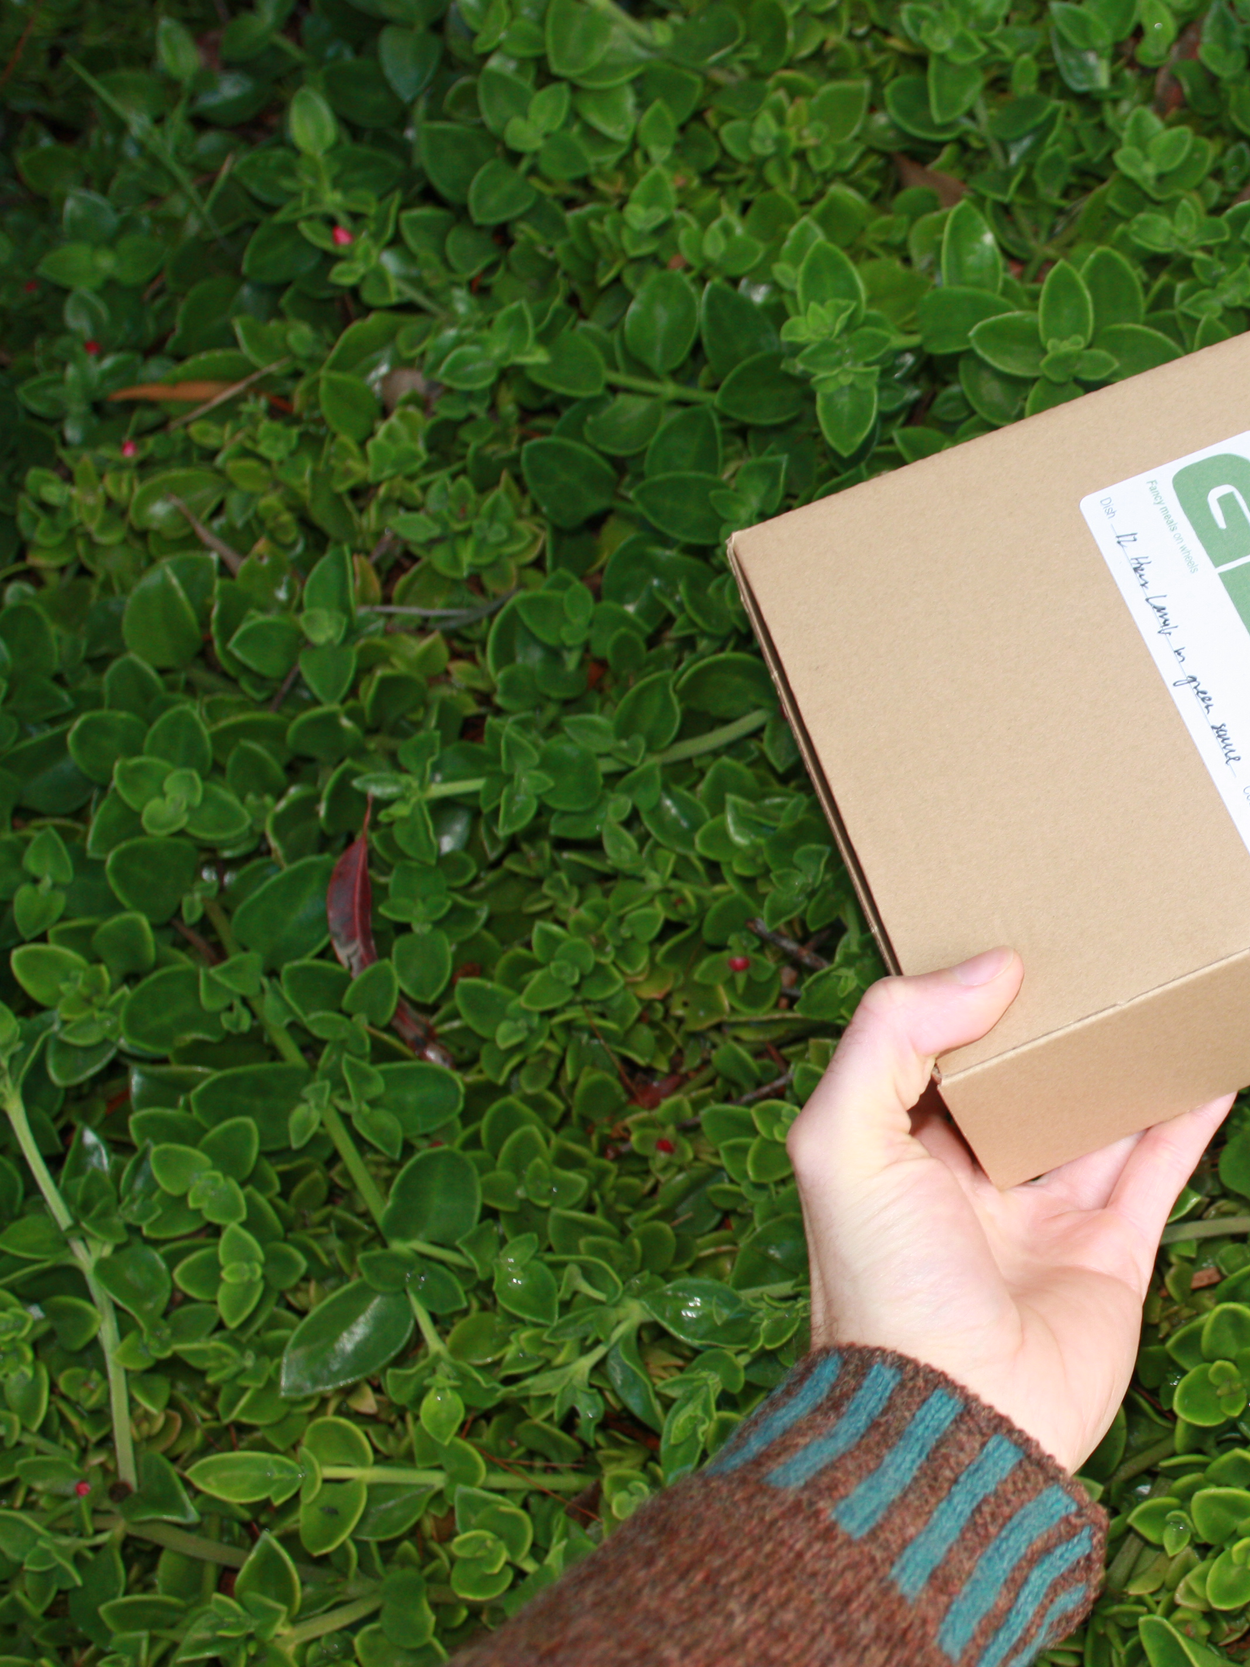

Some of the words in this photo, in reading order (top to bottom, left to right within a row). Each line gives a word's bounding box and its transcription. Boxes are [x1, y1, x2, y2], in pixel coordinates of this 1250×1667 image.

[1100, 496, 1117, 519] Dish
[1146, 479, 1165, 505] Fancy
[1160, 506, 1178, 532] meals
[1173, 532, 1184, 545] on
[1179, 544, 1199, 574] wheels
[1115, 532, 1138, 548] 12
[1172, 675, 1214, 714] green
